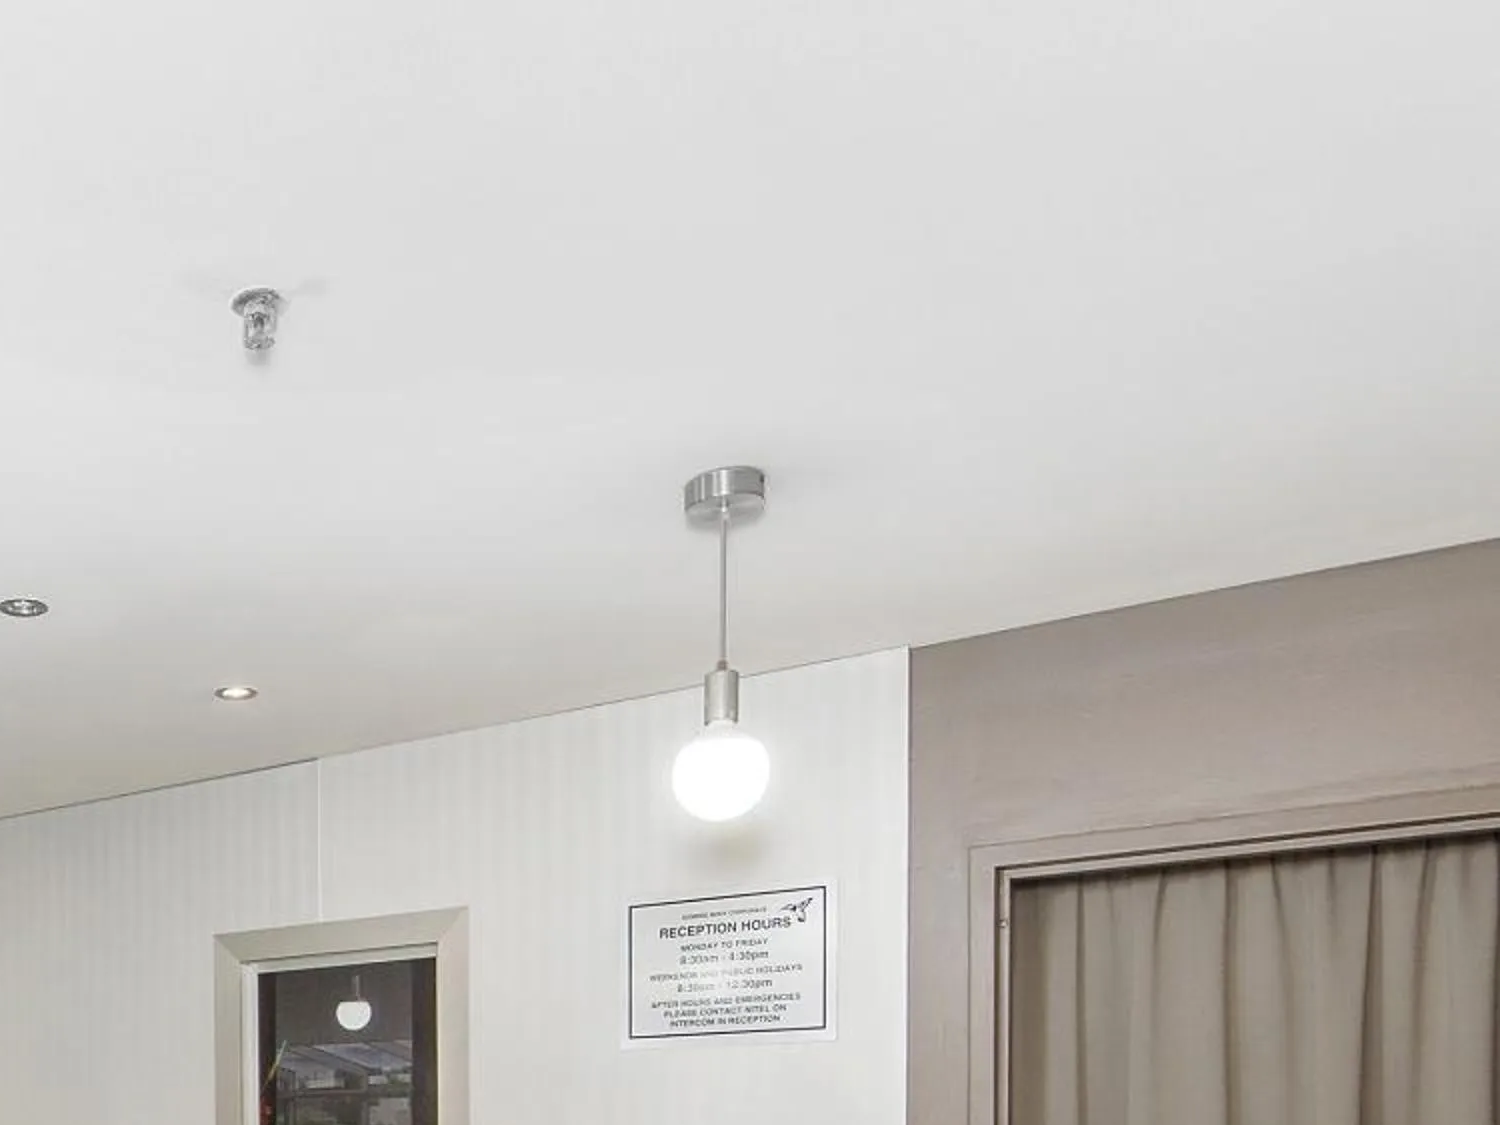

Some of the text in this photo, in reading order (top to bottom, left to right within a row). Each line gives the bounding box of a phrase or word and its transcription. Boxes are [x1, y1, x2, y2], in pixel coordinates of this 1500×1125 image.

[659, 916, 792, 939] RECEPTION HOURS
[680, 938, 768, 951] MONDAY TO FRIDAY
[755, 964, 803, 973] HOLIDAYS
[651, 1000, 679, 1008] AFTER
[680, 998, 710, 1006] HOURS
[735, 992, 800, 1003] EMERGENCIES
[663, 1009, 697, 1018] PLEASE
[699, 1006, 742, 1016] CONTACT
[772, 1003, 787, 1012] ON
[669, 1015, 780, 1027] INTERCOM IN RECEPTION
